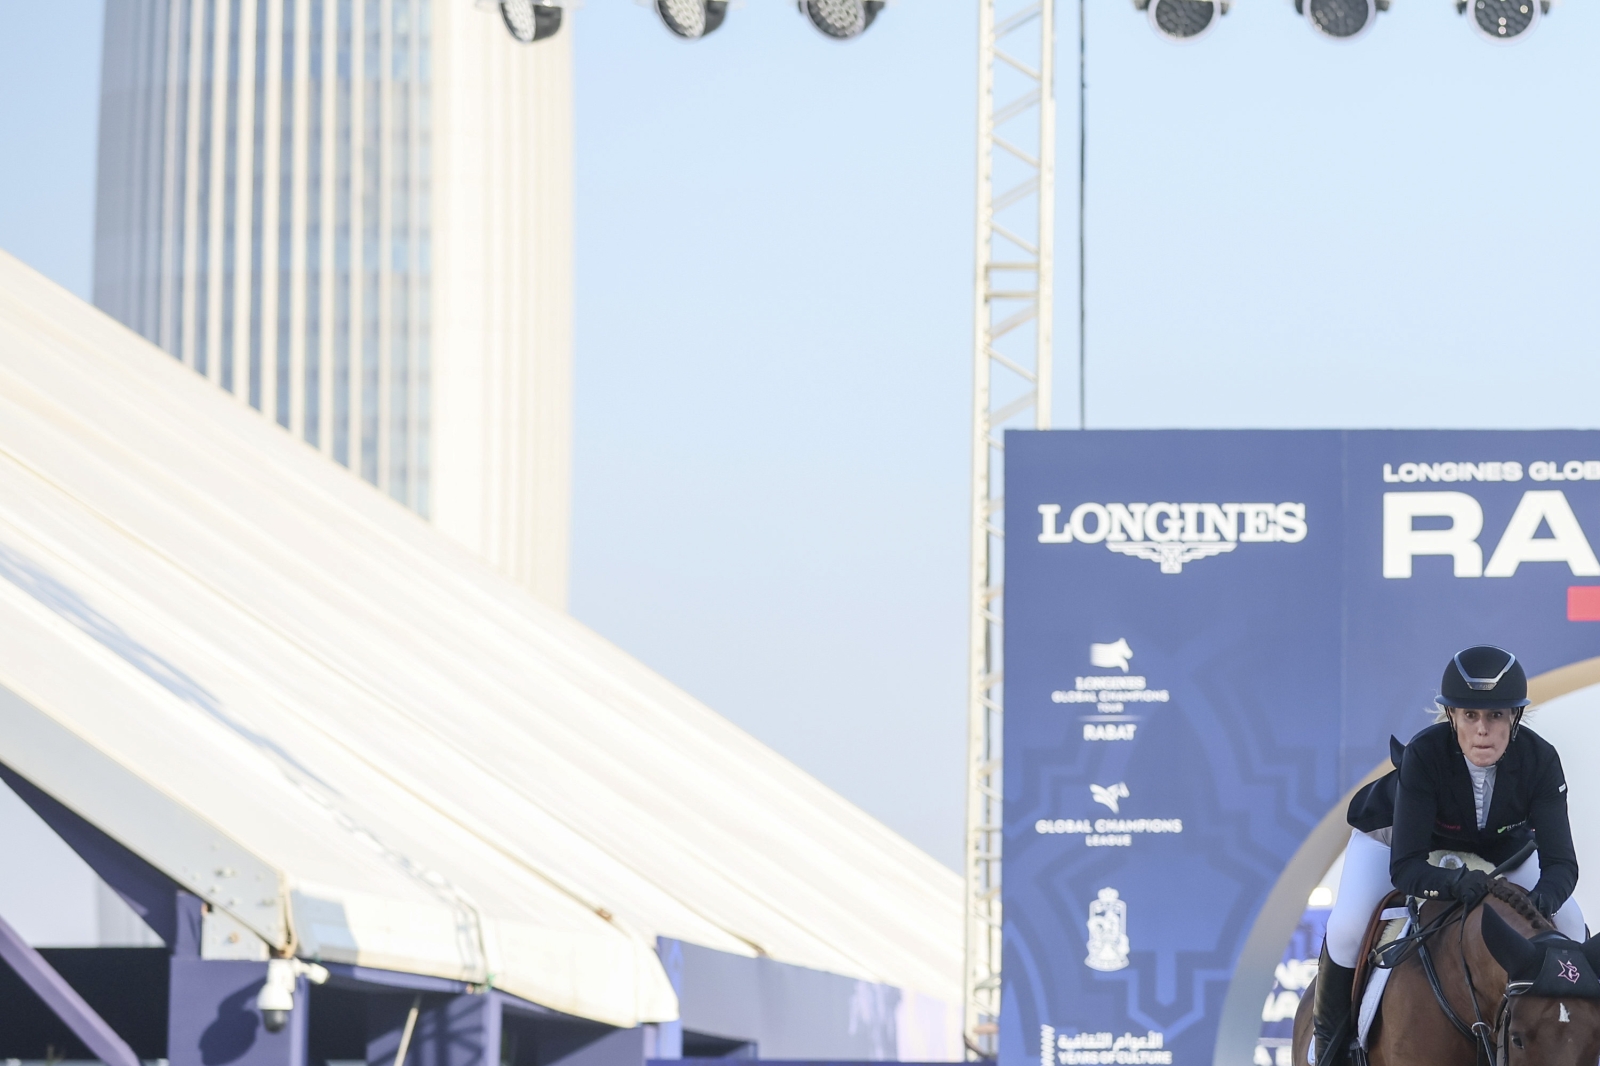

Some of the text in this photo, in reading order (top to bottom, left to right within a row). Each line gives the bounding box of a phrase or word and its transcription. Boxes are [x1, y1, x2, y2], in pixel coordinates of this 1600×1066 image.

[1383, 462, 1523, 483] LONGINES
[1038, 502, 1307, 543] LONGINES
[1075, 676, 1146, 690] LONGINES
[1084, 724, 1136, 740] RABAT
[1035, 819, 1182, 834] GLOBAL CHAMPIONS
[1086, 834, 1131, 846] LEAGUE
